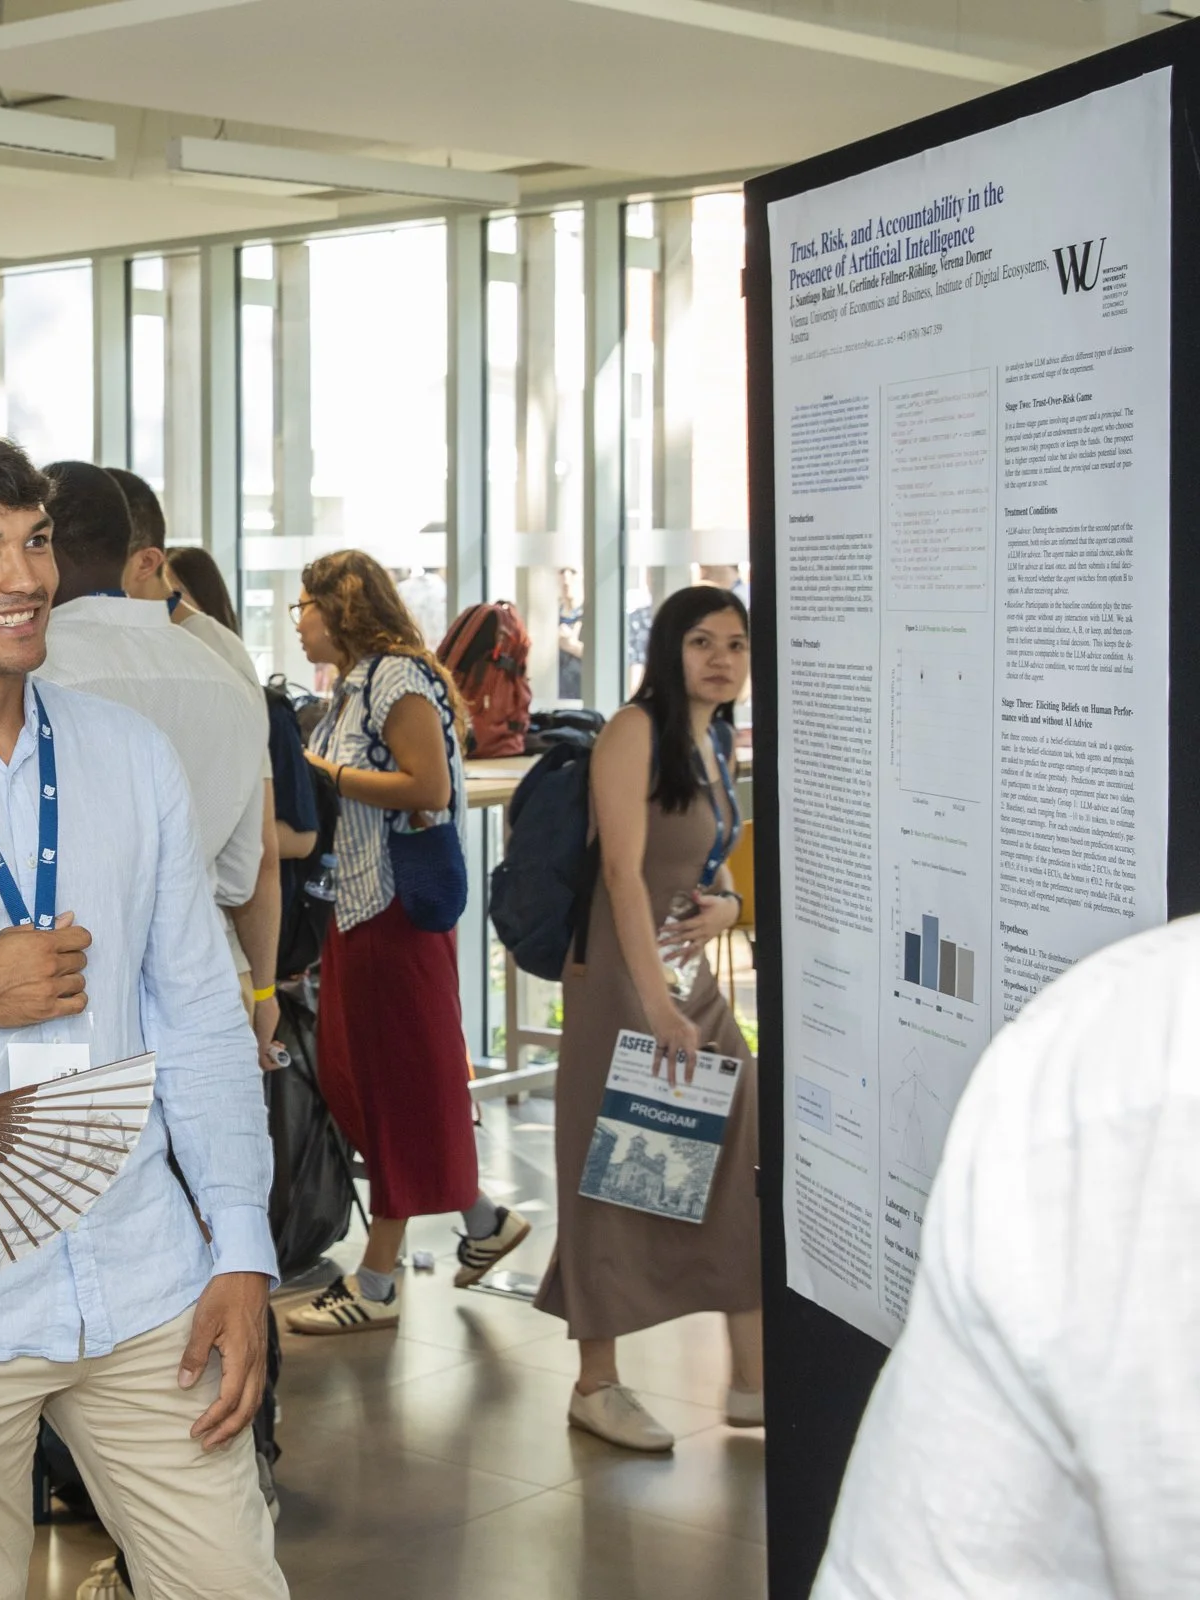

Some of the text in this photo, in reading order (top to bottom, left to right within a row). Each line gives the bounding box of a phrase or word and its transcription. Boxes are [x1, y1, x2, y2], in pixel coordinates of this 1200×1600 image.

[790, 181, 1004, 263] Trust, Risk, and Accountability in the
[789, 225, 975, 290] Presence of Artificial Intelligence
[822, 286, 835, 300] Ruiz
[850, 277, 879, 293] Gerlinde
[881, 261, 938, 286] Fellner-Röhling,
[940, 255, 963, 271] Verena
[965, 249, 992, 266] Dorner
[1052, 237, 1107, 295] WU
[810, 307, 838, 325] University
[840, 303, 847, 316] of
[849, 297, 885, 315] Economics
[887, 292, 899, 307] and
[902, 286, 933, 303] Business,
[936, 278, 962, 296] Institute
[965, 272, 973, 288] of
[975, 266, 1000, 288] Digital
[1002, 257, 1049, 284] Ecosystems,
[1076, 392, 1093, 403] Game
[1030, 715, 1041, 724] and
[1073, 719, 1093, 729] Advice
[1061, 702, 1080, 712] Beliefs
[1081, 705, 1089, 713] on
[1091, 704, 1112, 715] Human
[619, 1035, 655, 1054] ASFEE
[629, 1102, 697, 1129] PROGRAM
